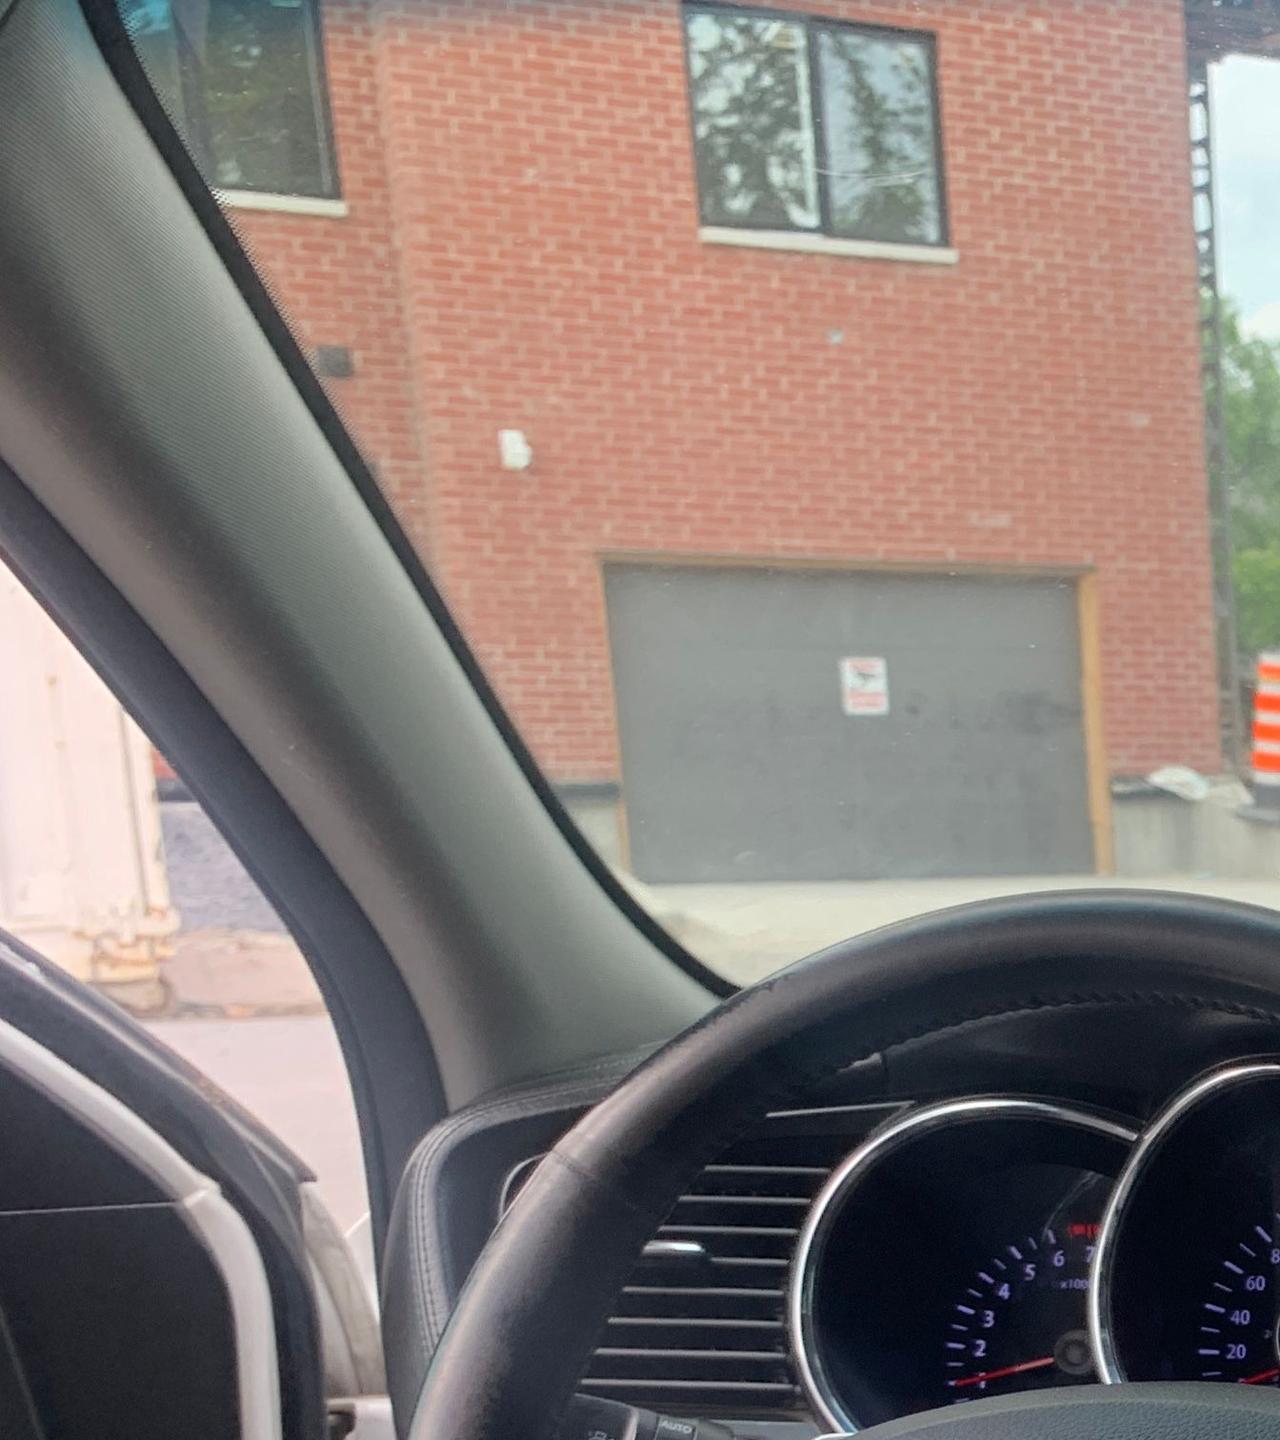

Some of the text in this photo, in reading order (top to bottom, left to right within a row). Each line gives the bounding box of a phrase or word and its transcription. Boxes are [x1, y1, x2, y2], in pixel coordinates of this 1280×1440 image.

[1053, 1250, 1064, 1267] 6
[1025, 1264, 1036, 1280] 5
[998, 1283, 1010, 1300] 4
[1246, 1276, 1266, 1291] 60
[983, 1310, 995, 1328] 3
[1230, 1310, 1250, 1325] 40
[974, 1339, 986, 1357] 2
[1226, 1344, 1246, 1359] 20
[661, 1420, 692, 1434] AUTO
